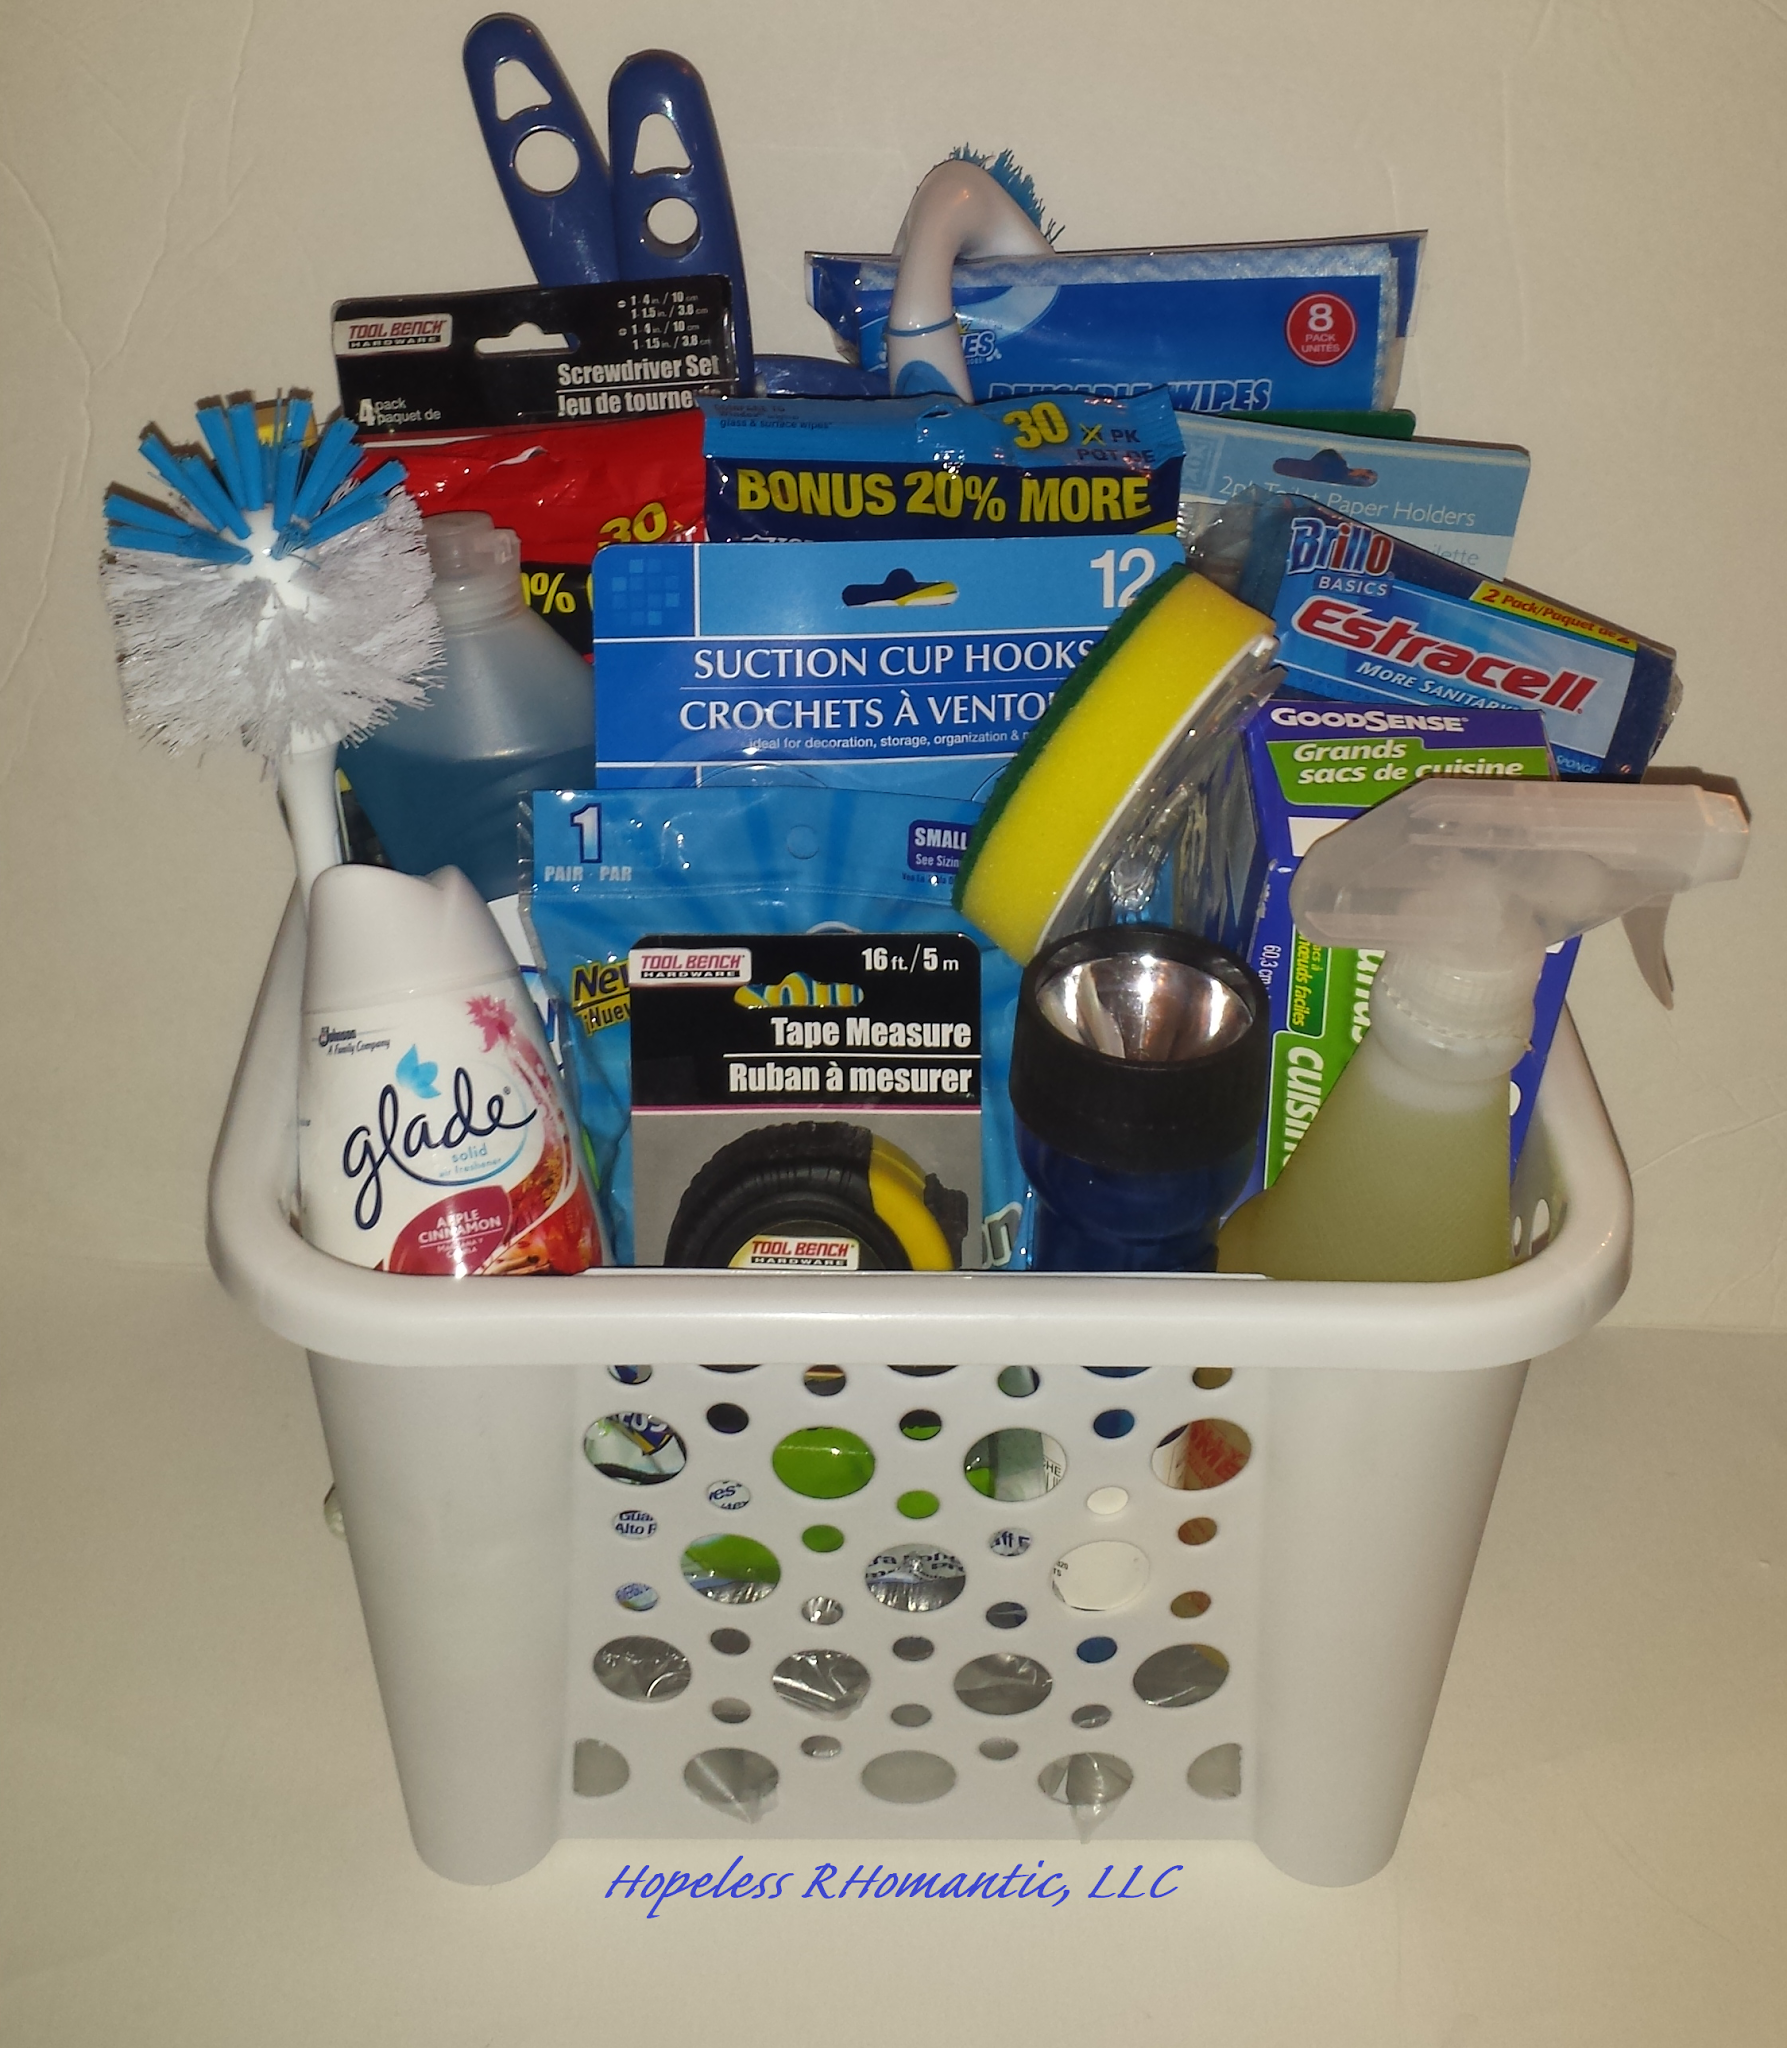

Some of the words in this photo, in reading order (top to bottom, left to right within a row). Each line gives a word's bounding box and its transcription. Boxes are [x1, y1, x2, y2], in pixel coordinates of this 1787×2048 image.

[672, 291, 684, 303] 10
[349, 322, 388, 339] TOOL
[389, 319, 445, 336] BENCH
[673, 320, 686, 333] 10
[1307, 303, 1335, 332] 8
[1300, 341, 1341, 353] UNITÉS
[1305, 333, 1336, 343] PACK
[557, 358, 682, 386] Screwdriver
[685, 354, 720, 377] Set
[374, 397, 406, 413] pack
[595, 391, 622, 415] de
[625, 388, 700, 412] tourne
[1168, 378, 1273, 414] WIPES
[358, 398, 376, 426] 4
[376, 409, 422, 425] paquet
[424, 408, 442, 420] de
[1003, 401, 1070, 450] 30
[1110, 428, 1141, 443] PK
[737, 468, 896, 518] BONUS
[903, 470, 1007, 522] 20%
[1018, 476, 1151, 523] MORE
[1327, 493, 1388, 518] Paper
[1394, 502, 1477, 527] Holders
[1287, 517, 1394, 577] Brillo
[1090, 547, 1156, 608] 12
[1318, 576, 1388, 595] BASICS
[1482, 589, 1500, 603] 2
[694, 646, 867, 680] SUCTION
[879, 644, 954, 677] CUP
[966, 639, 1093, 672] HOOKS
[1295, 596, 1600, 714] Estracell
[1356, 661, 1415, 689] MORE
[679, 697, 884, 731] CROCHETS
[894, 689, 920, 726] À
[929, 691, 1056, 726] VENTO
[750, 738, 780, 749] ideal
[784, 737, 801, 748] for
[805, 736, 877, 750] decoration,
[880, 734, 931, 749] storage,
[934, 731, 1008, 746] organization
[1010, 730, 1020, 740] &
[1293, 738, 1407, 763] Grands
[1299, 762, 1366, 785] sacs
[1374, 762, 1409, 782] de
[1556, 754, 1598, 775] SPONGE
[570, 803, 602, 863] 1
[914, 827, 967, 851] SMALL
[915, 853, 934, 866] See
[936, 854, 960, 868] Sizin
[544, 866, 583, 882] PAIR
[600, 865, 632, 882] PAR
[641, 954, 683, 970] TOOL
[685, 954, 743, 970] BENCH
[862, 947, 888, 971] 16
[943, 958, 959, 971] m
[642, 970, 738, 978] HARDWARE
[771, 1017, 840, 1048] Tape
[846, 1017, 972, 1048] Measure
[729, 1062, 820, 1092] Ruban
[826, 1061, 843, 1092] à
[849, 1068, 973, 1093] mesurer
[1282, 1046, 1324, 1168] cuisi
[343, 1067, 538, 1230] glade
[452, 1142, 488, 1163] solid
[752, 1240, 792, 1256] TOOL
[795, 1241, 849, 1256] BENCH
[753, 1257, 847, 1266] HARDWARE
